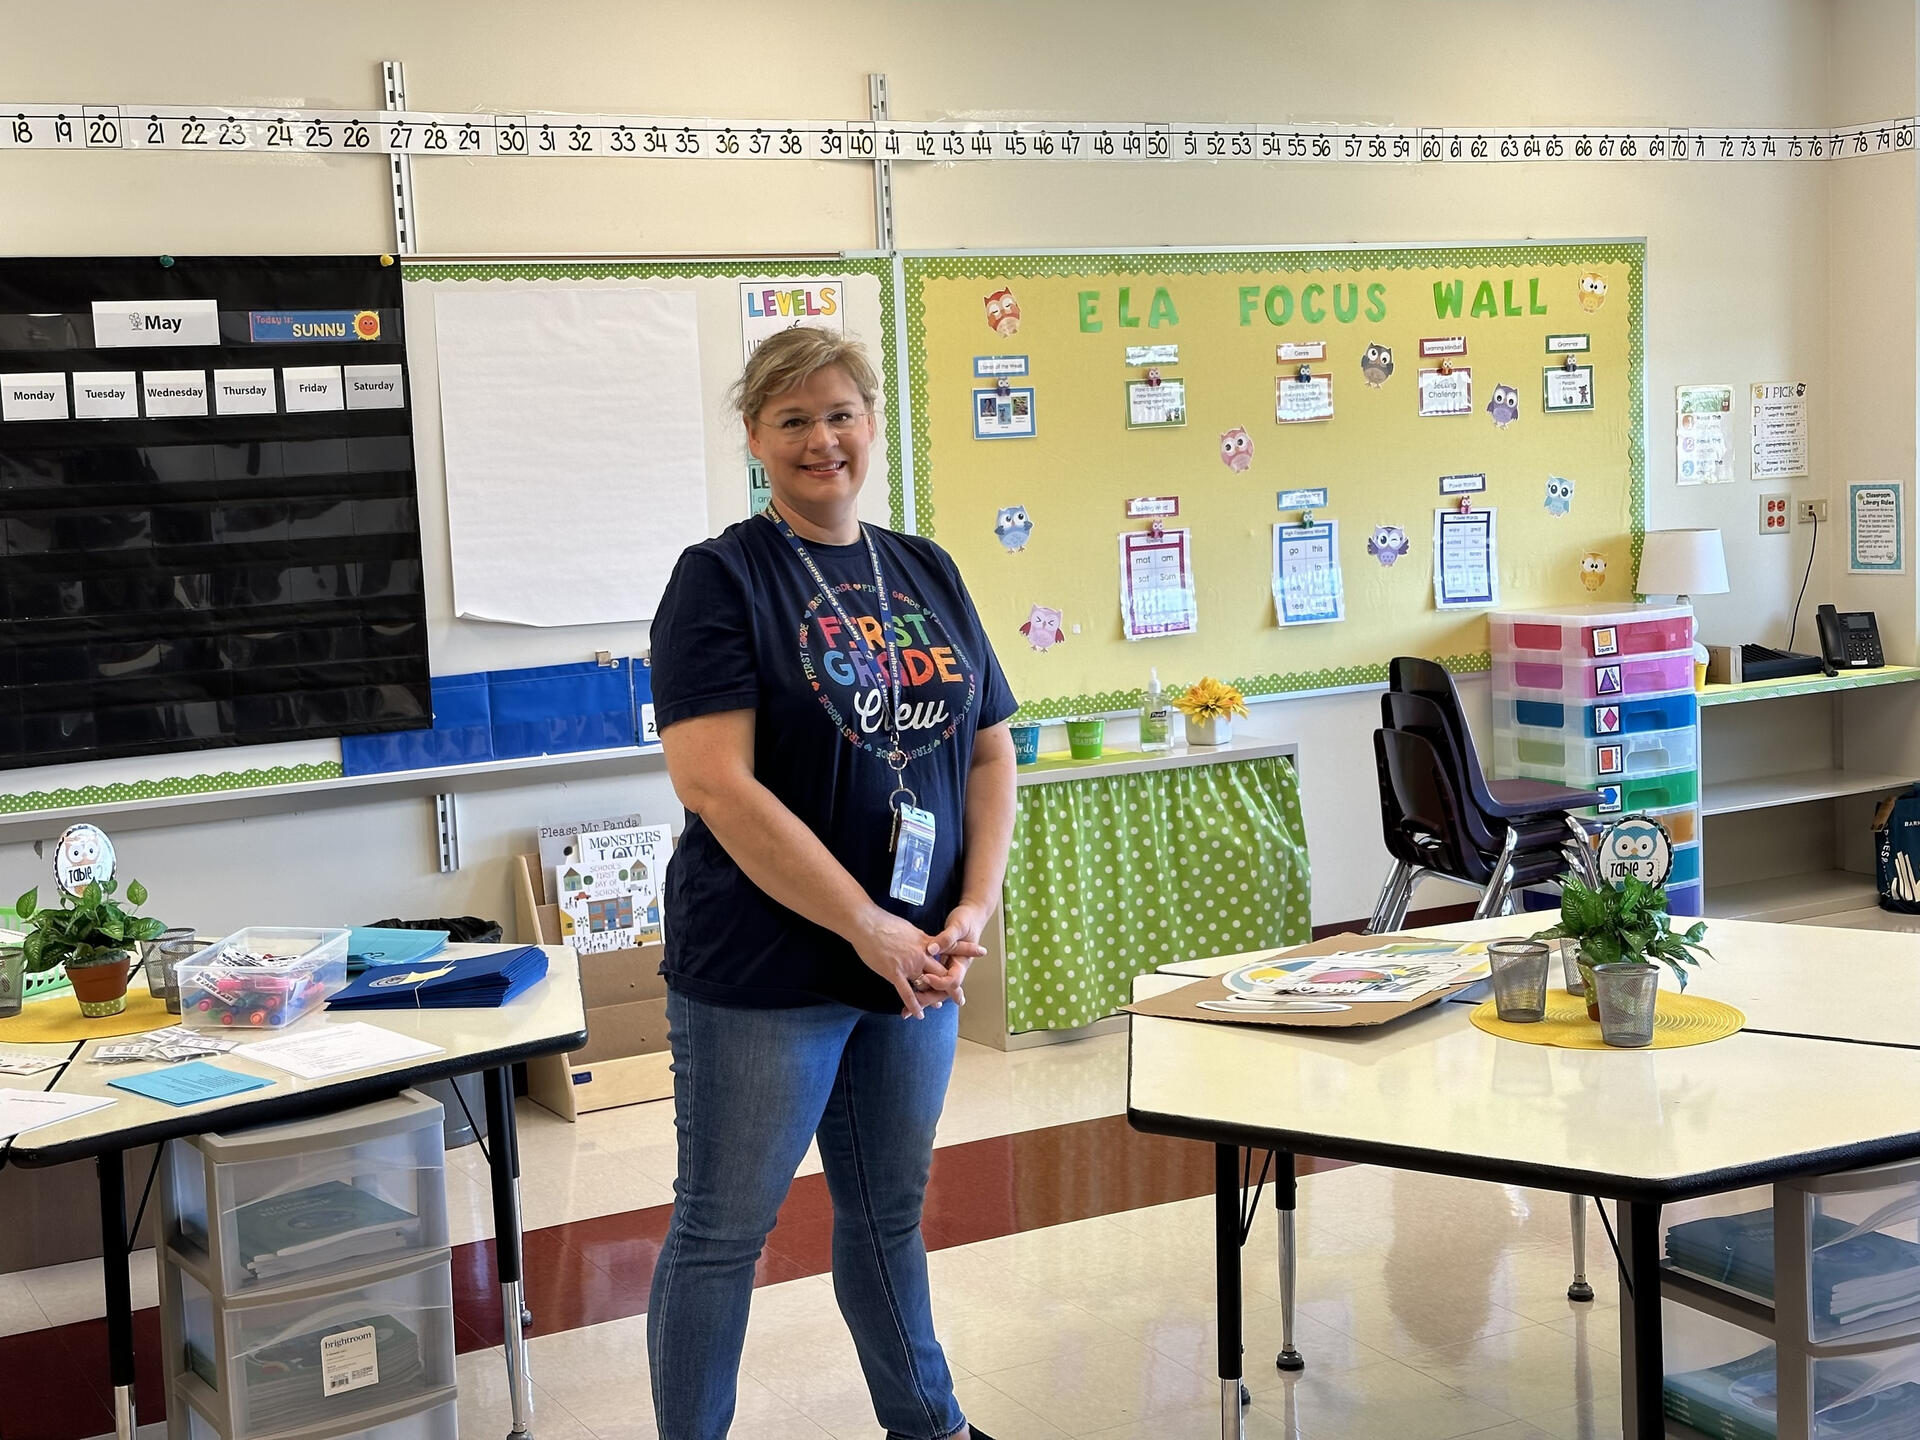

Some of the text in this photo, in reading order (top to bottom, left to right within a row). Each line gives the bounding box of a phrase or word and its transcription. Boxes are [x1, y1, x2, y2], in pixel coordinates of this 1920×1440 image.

[12, 121, 1912, 158] 18 19 20 21 22 23 24 25 26 27 28 29 30 31 32 33 34 35 36 37 38 39 40 41 42 43 44 45 46 47 48 49 50 51 52 53 54 55 56 57 58 59 60 61 62 63 64 65 66 67 68 69 70 71 72 73 74 75 76 77 78 79 80
[747, 287, 837, 318] LEVELS
[1077, 277, 1548, 334] ELA FOCUS WALL
[144, 315, 183, 333] May
[255, 314, 282, 326] Today
[292, 322, 347, 338] SUNNY
[13, 380, 395, 402] Monday Tuesday Wednesday Thursday Friday Saturday
[1765, 385, 1794, 398] I PICK
[1754, 405, 1761, 418] P
[1753, 424, 1757, 436] I
[1753, 443, 1760, 455] C
[1754, 462, 1760, 474] K
[1136, 553, 1174, 564] mat am
[1289, 545, 1323, 556] go this
[1138, 572, 1177, 584] sat Sam
[800, 652, 817, 681] FIRST
[888, 641, 899, 678] Hawthorn
[648, 722, 657, 733] 2
[541, 825, 578, 838] Please
[603, 817, 639, 830] Panda
[589, 830, 661, 850] MONSTERS
[68, 865, 93, 884] Table
[1610, 861, 1654, 878] Table 3
[595, 888, 622, 897] SCHOOL
[324, 1332, 372, 1349] brightroom
